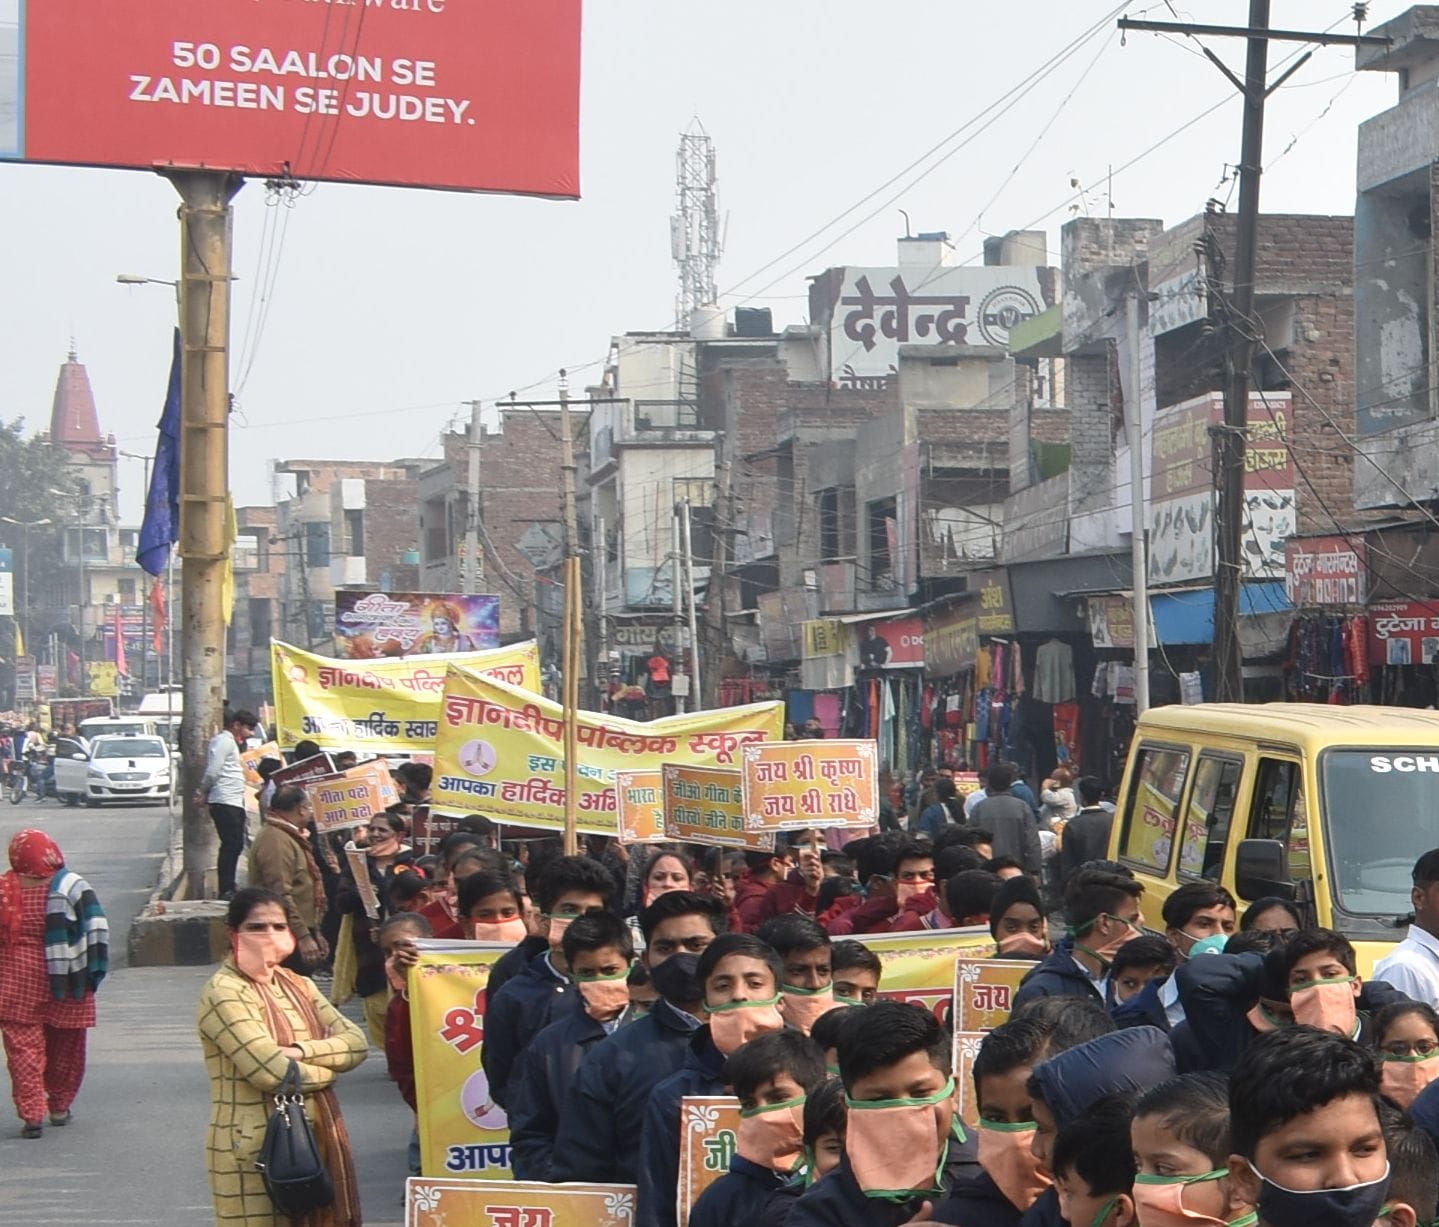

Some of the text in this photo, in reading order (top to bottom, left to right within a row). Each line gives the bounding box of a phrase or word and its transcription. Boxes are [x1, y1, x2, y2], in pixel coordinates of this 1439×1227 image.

[173, 41, 436, 87] 50 SAALON SE
[129, 75, 477, 125] ZAMEEN SE JUDEY.
[842, 274, 971, 353] देवेन्द्र
[1375, 612, 1426, 640] टुटेजा
[527, 754, 556, 775] इस
[756, 754, 864, 788] जय श्री कृष्ण
[438, 775, 497, 798] आपका
[627, 787, 656, 804] भारत
[703, 783, 731, 803] गीता
[763, 786, 858, 817] जय श्री राधे
